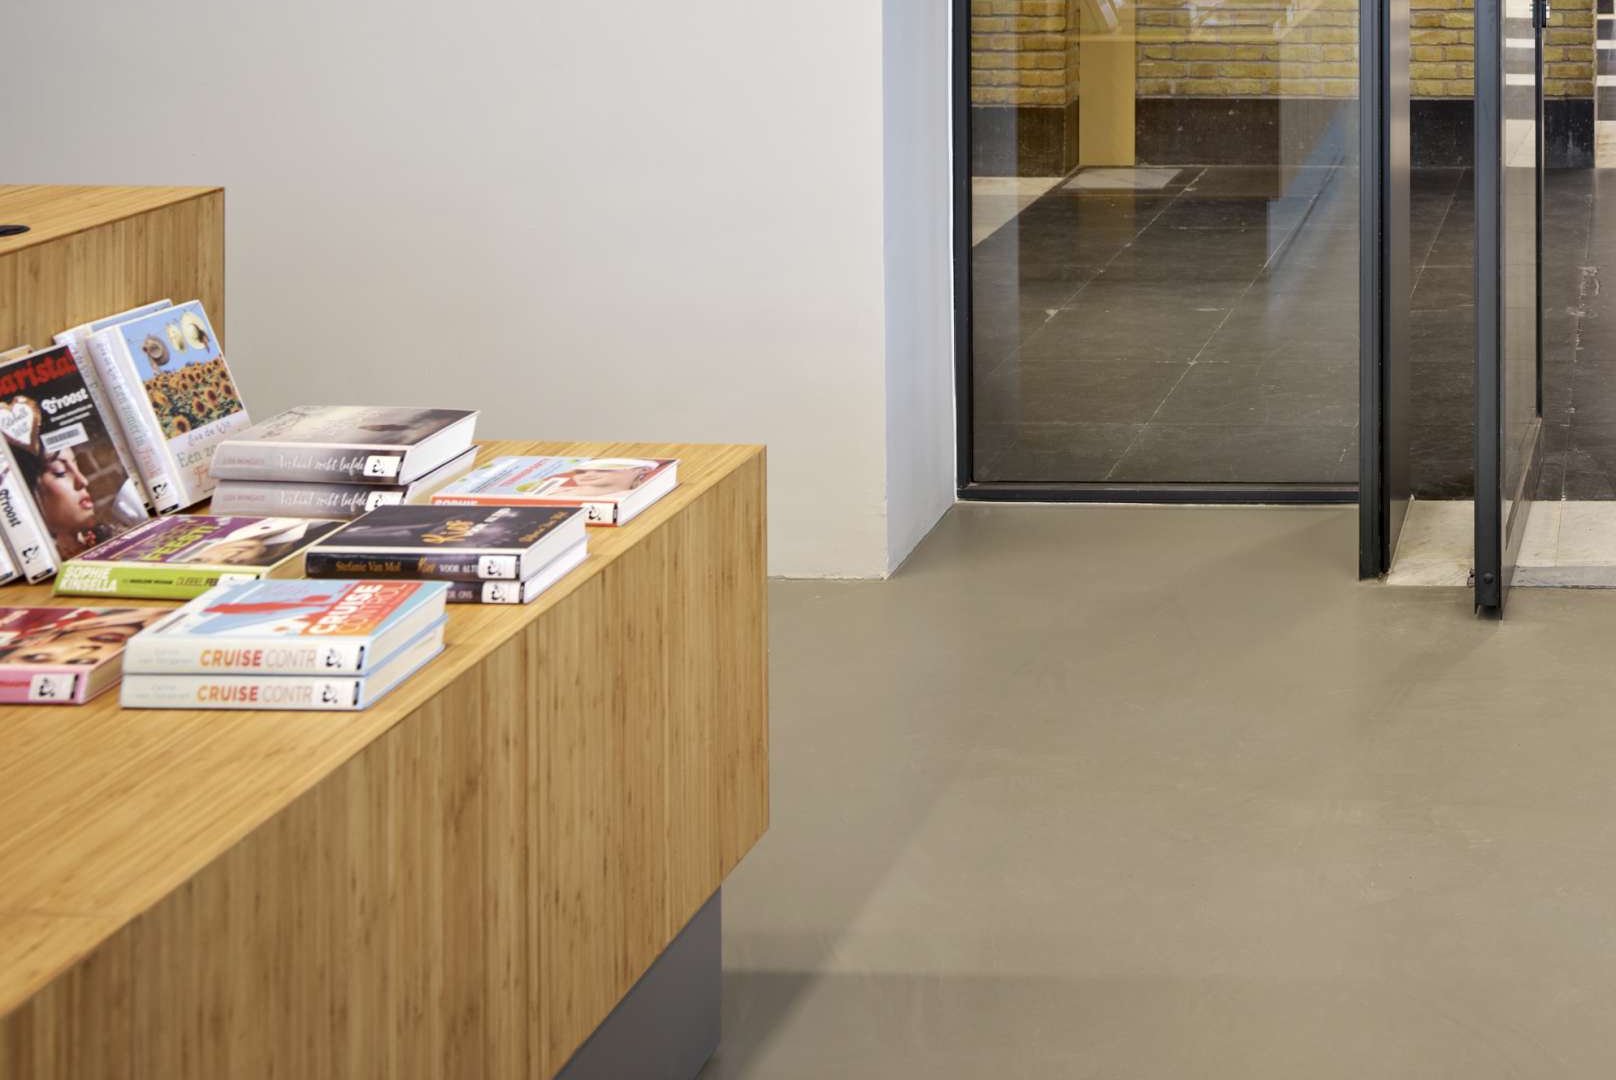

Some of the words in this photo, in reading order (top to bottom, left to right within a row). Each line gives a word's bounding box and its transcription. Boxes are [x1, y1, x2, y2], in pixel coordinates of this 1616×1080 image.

[63, 566, 113, 580] SOPHIE
[58, 578, 118, 593] KINSELLA
[308, 584, 384, 634] CRUISE
[199, 649, 263, 668] CRUISE
[196, 684, 259, 703] CRUISE
